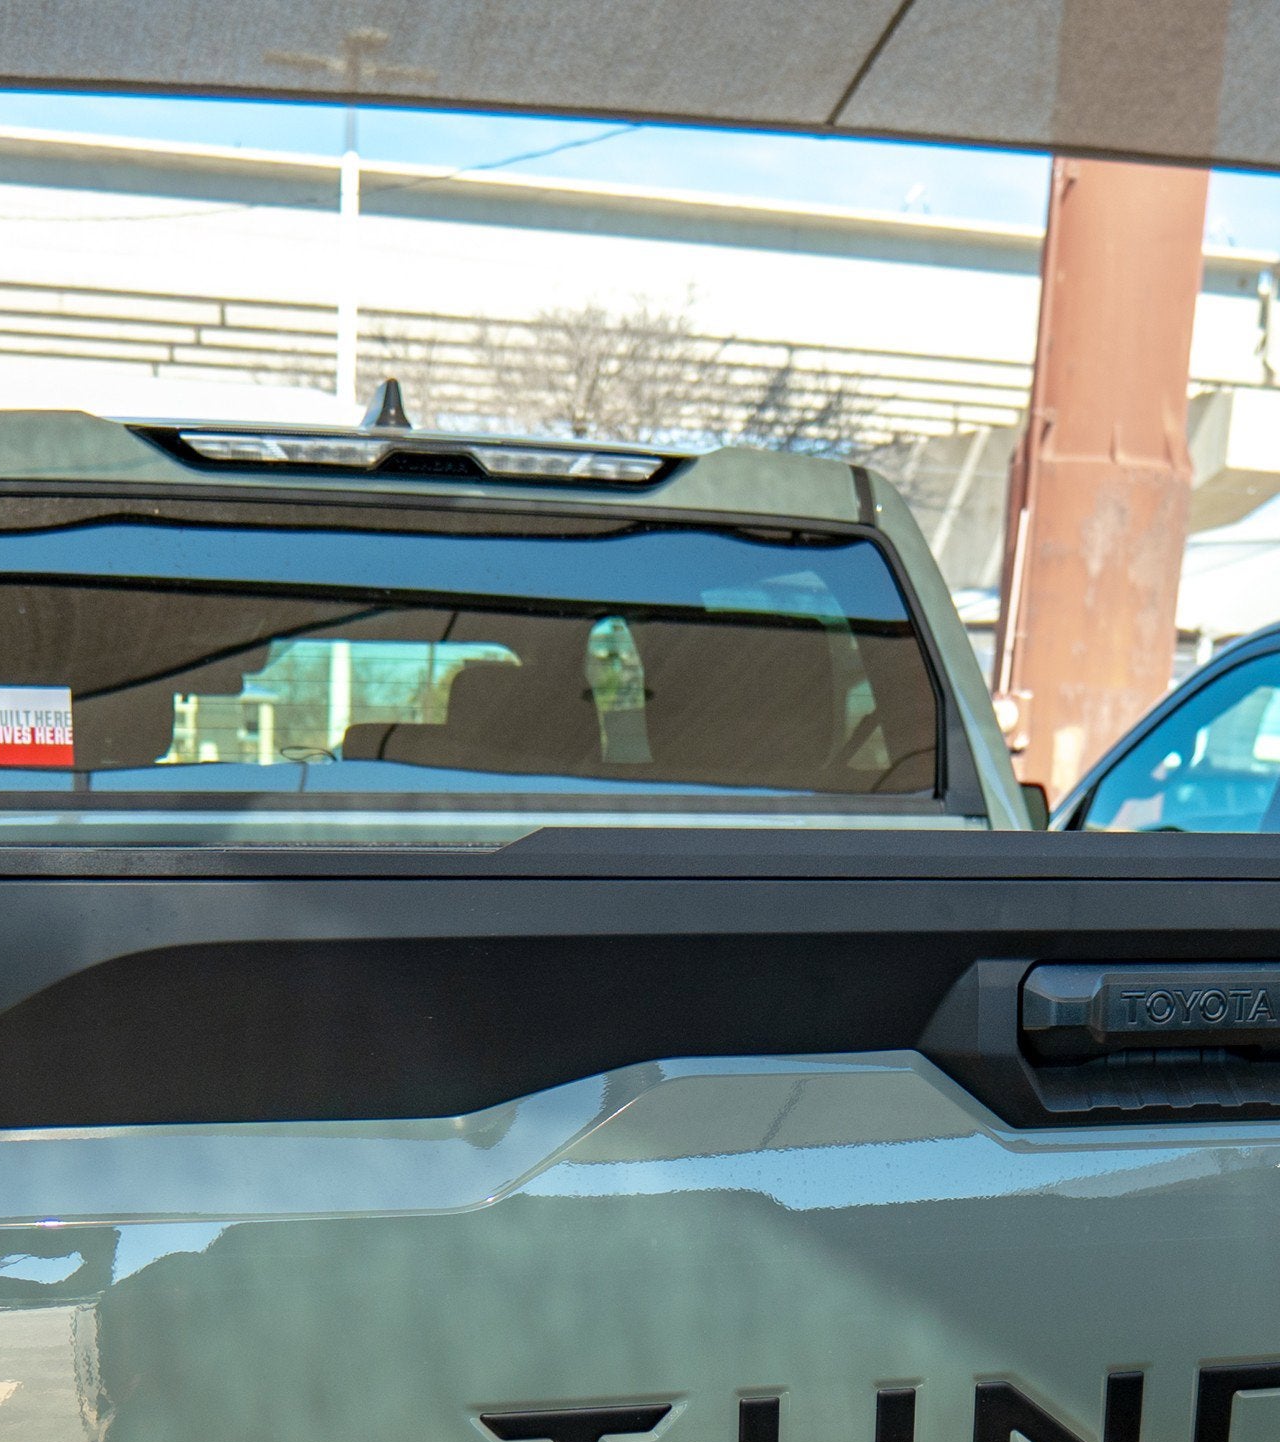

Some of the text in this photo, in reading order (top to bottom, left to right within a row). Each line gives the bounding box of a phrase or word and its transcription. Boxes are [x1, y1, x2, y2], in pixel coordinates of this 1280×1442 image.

[34, 710, 72, 727] HERE
[35, 727, 73, 745] HERE
[1120, 988, 1277, 1025] TOYOTA
